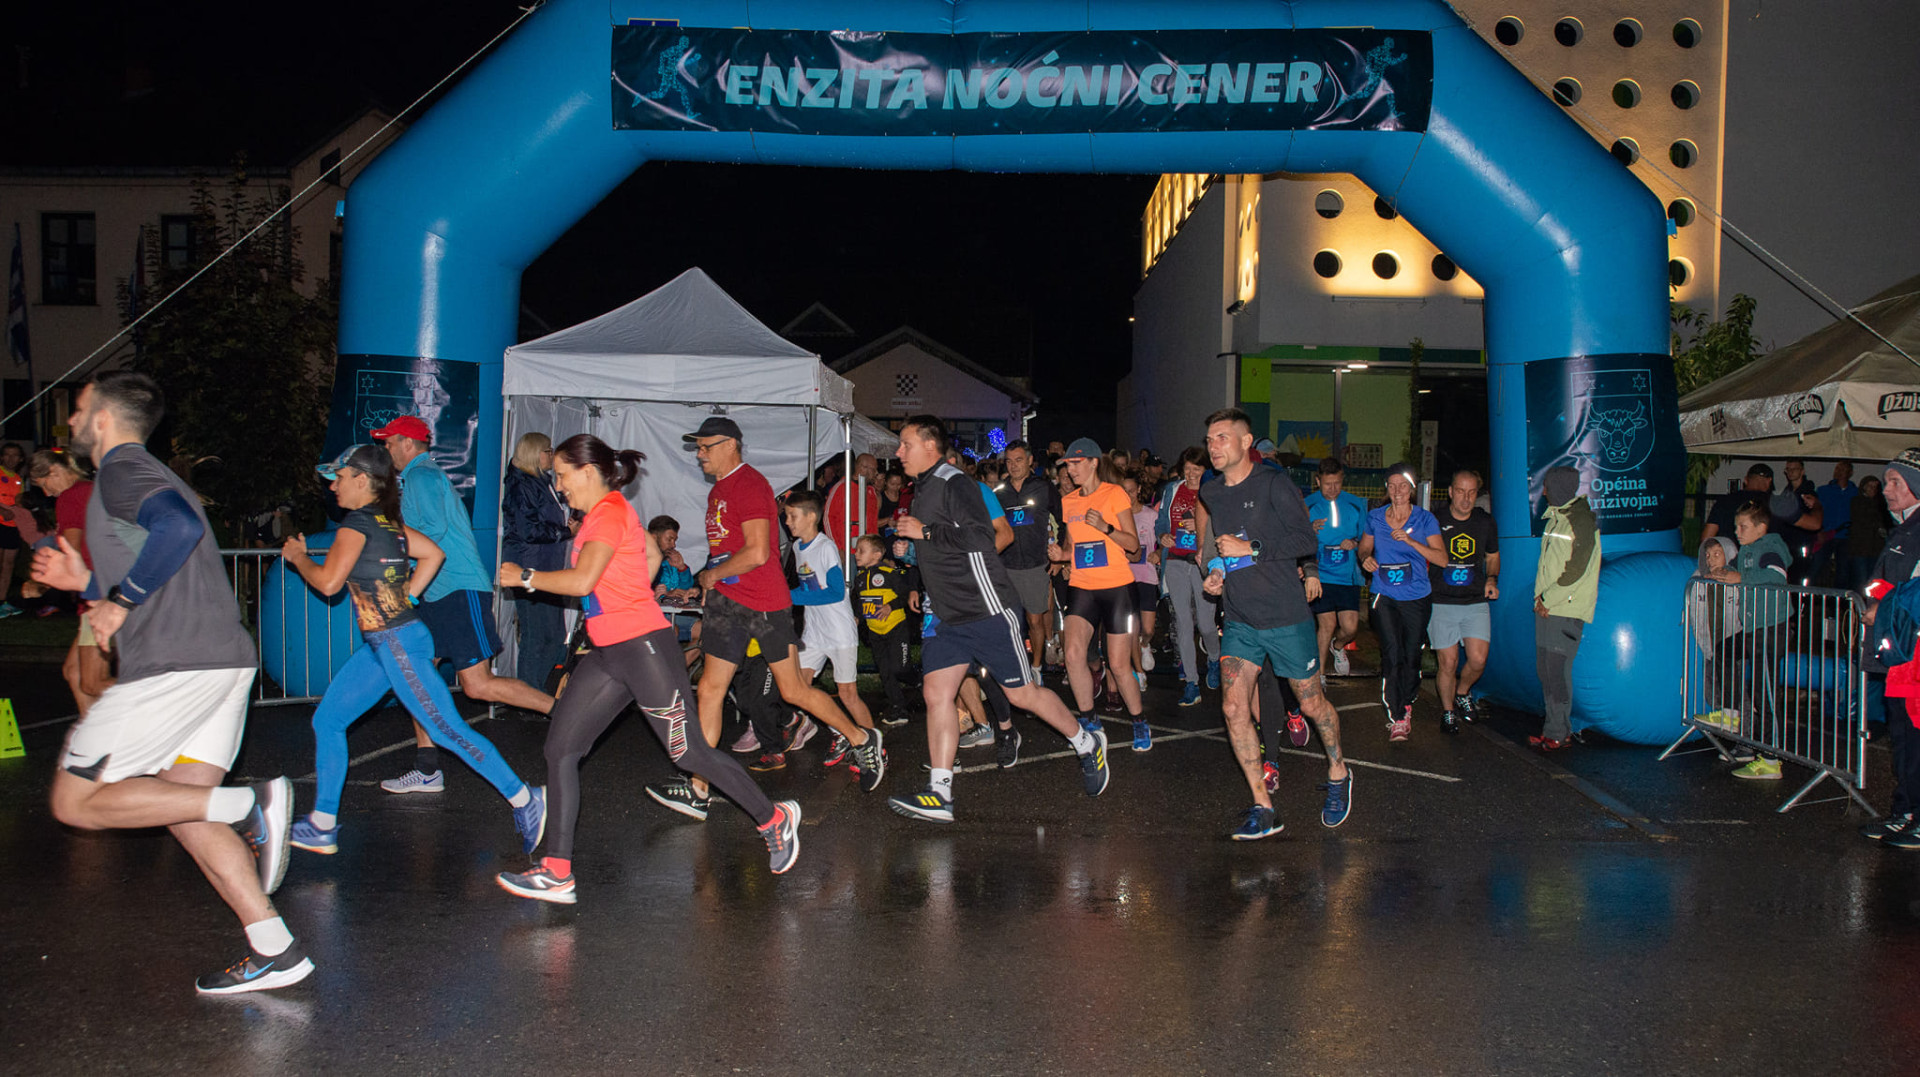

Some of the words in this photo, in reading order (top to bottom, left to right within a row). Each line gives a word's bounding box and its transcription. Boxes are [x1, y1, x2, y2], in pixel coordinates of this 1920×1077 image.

[724, 65, 928, 110] ENZITA
[941, 49, 1124, 110] NOĆNI
[1137, 61, 1323, 105] CENER
[1591, 476, 1647, 495] Općina
[1180, 534, 1197, 546] 63
[1084, 548, 1095, 564] 8
[1330, 550, 1344, 561] 55
[1386, 569, 1405, 584] 92
[1451, 569, 1469, 582] 66
